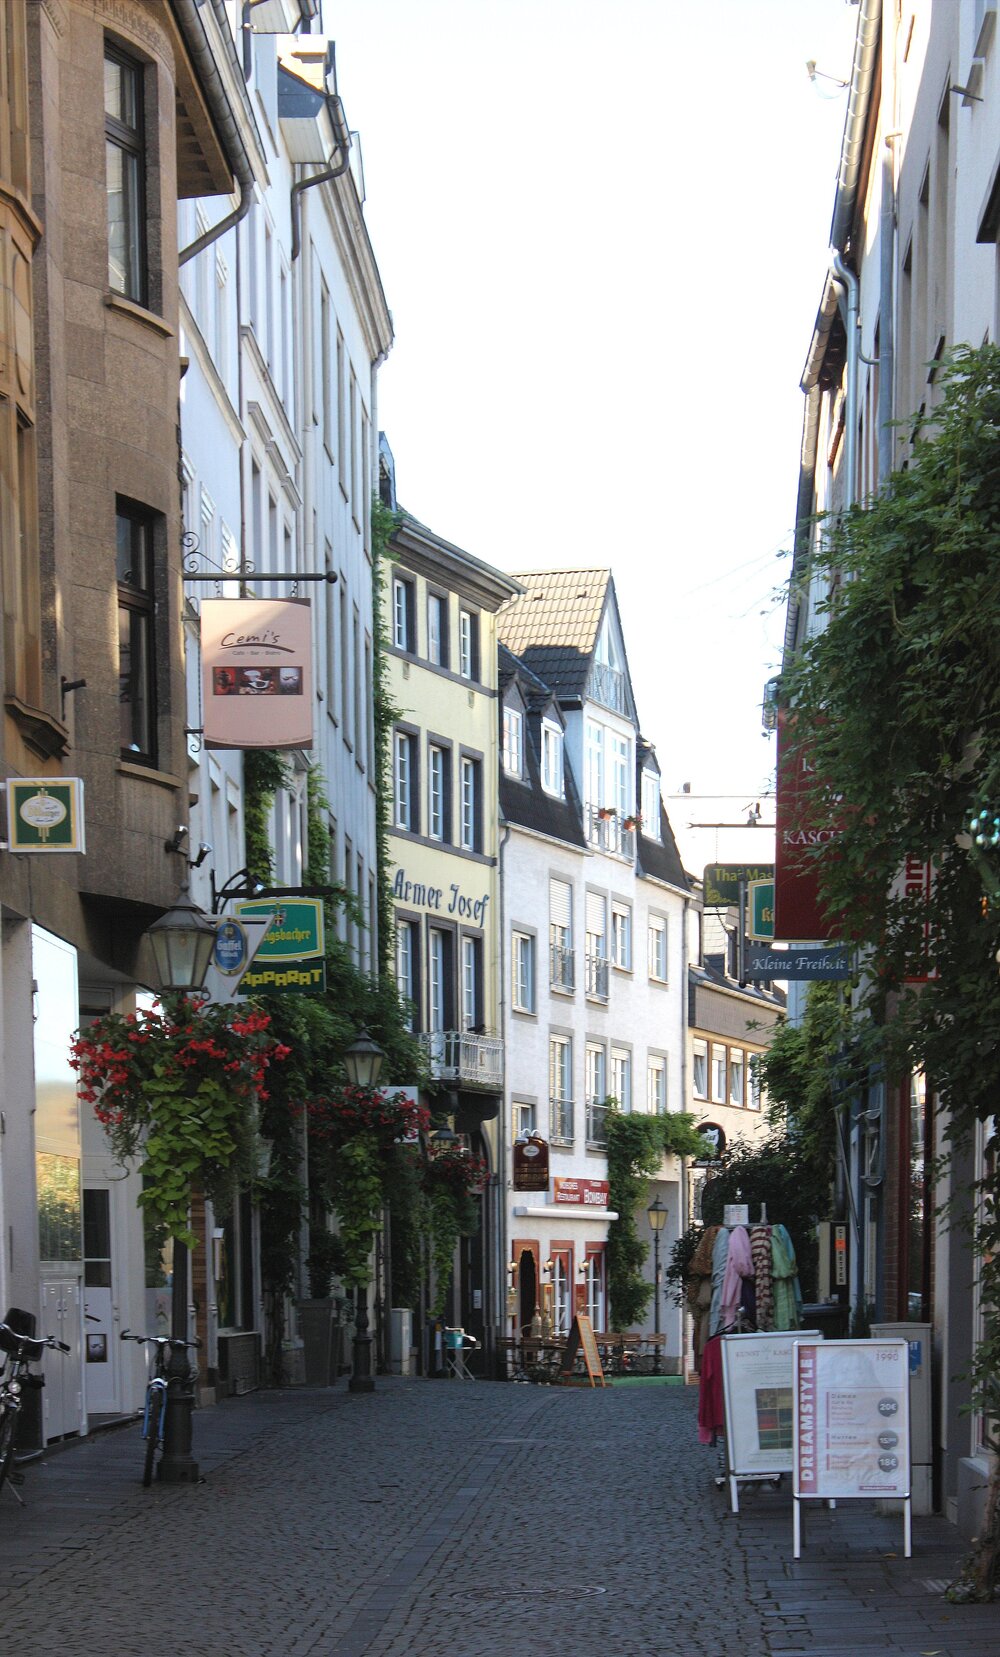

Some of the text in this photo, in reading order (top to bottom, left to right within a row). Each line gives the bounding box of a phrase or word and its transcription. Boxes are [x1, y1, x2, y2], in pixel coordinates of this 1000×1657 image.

[221, 630, 280, 647] Cemi's
[783, 830, 844, 844] KASC
[393, 868, 490, 928] Armer Josef
[752, 955, 792, 970] Kleine
[240, 969, 322, 987] APPARAT
[583, 1188, 608, 1204] BOMBAY
[876, 1353, 898, 1361] 1990
[879, 1403, 897, 1411] 20€
[800, 1358, 814, 1481] DREAMSTYLE
[879, 1458, 897, 1466] 18€
